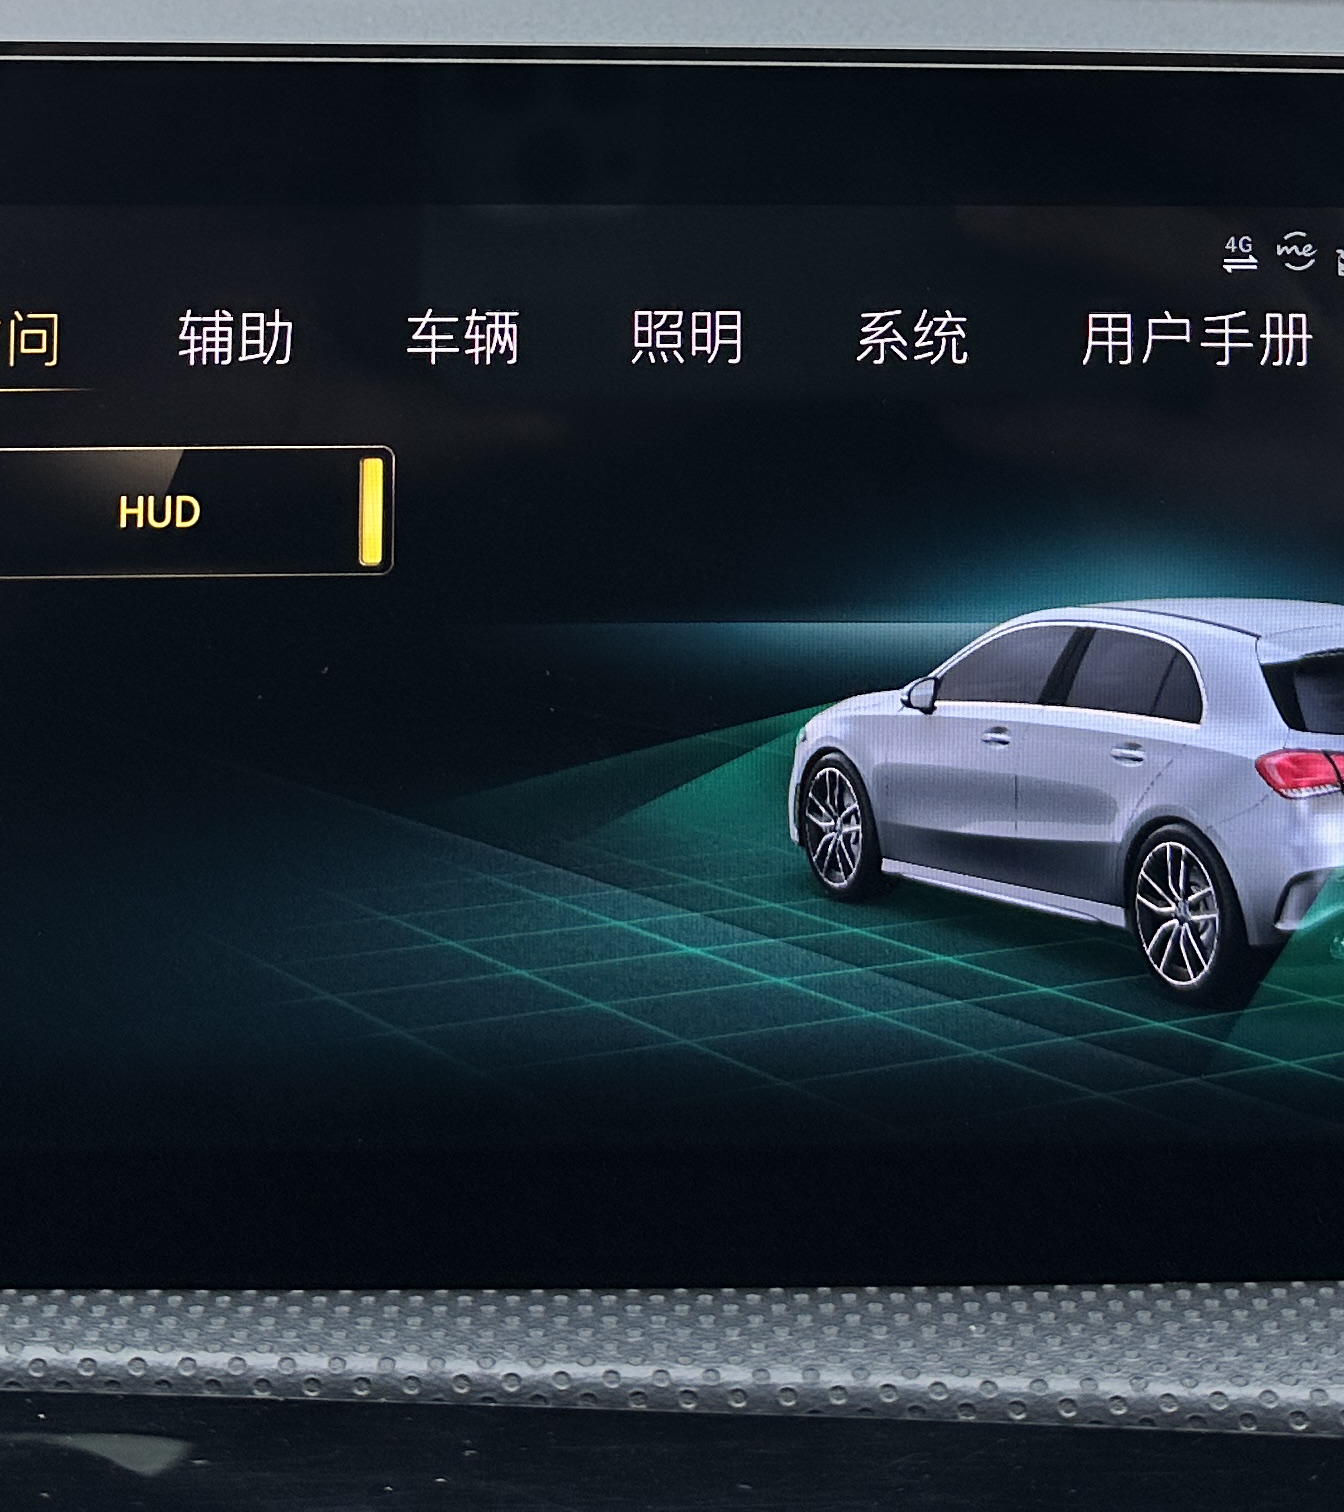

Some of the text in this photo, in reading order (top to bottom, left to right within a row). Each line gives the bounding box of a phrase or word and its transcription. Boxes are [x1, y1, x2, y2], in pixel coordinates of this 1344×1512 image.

[1224, 235, 1253, 253] 4G
[178, 308, 293, 366] 辅助
[406, 308, 520, 366] 车辆
[631, 309, 742, 365] 照明
[856, 308, 968, 366] 系统
[1082, 310, 1314, 367] 用户手册
[119, 495, 201, 529] HUD
